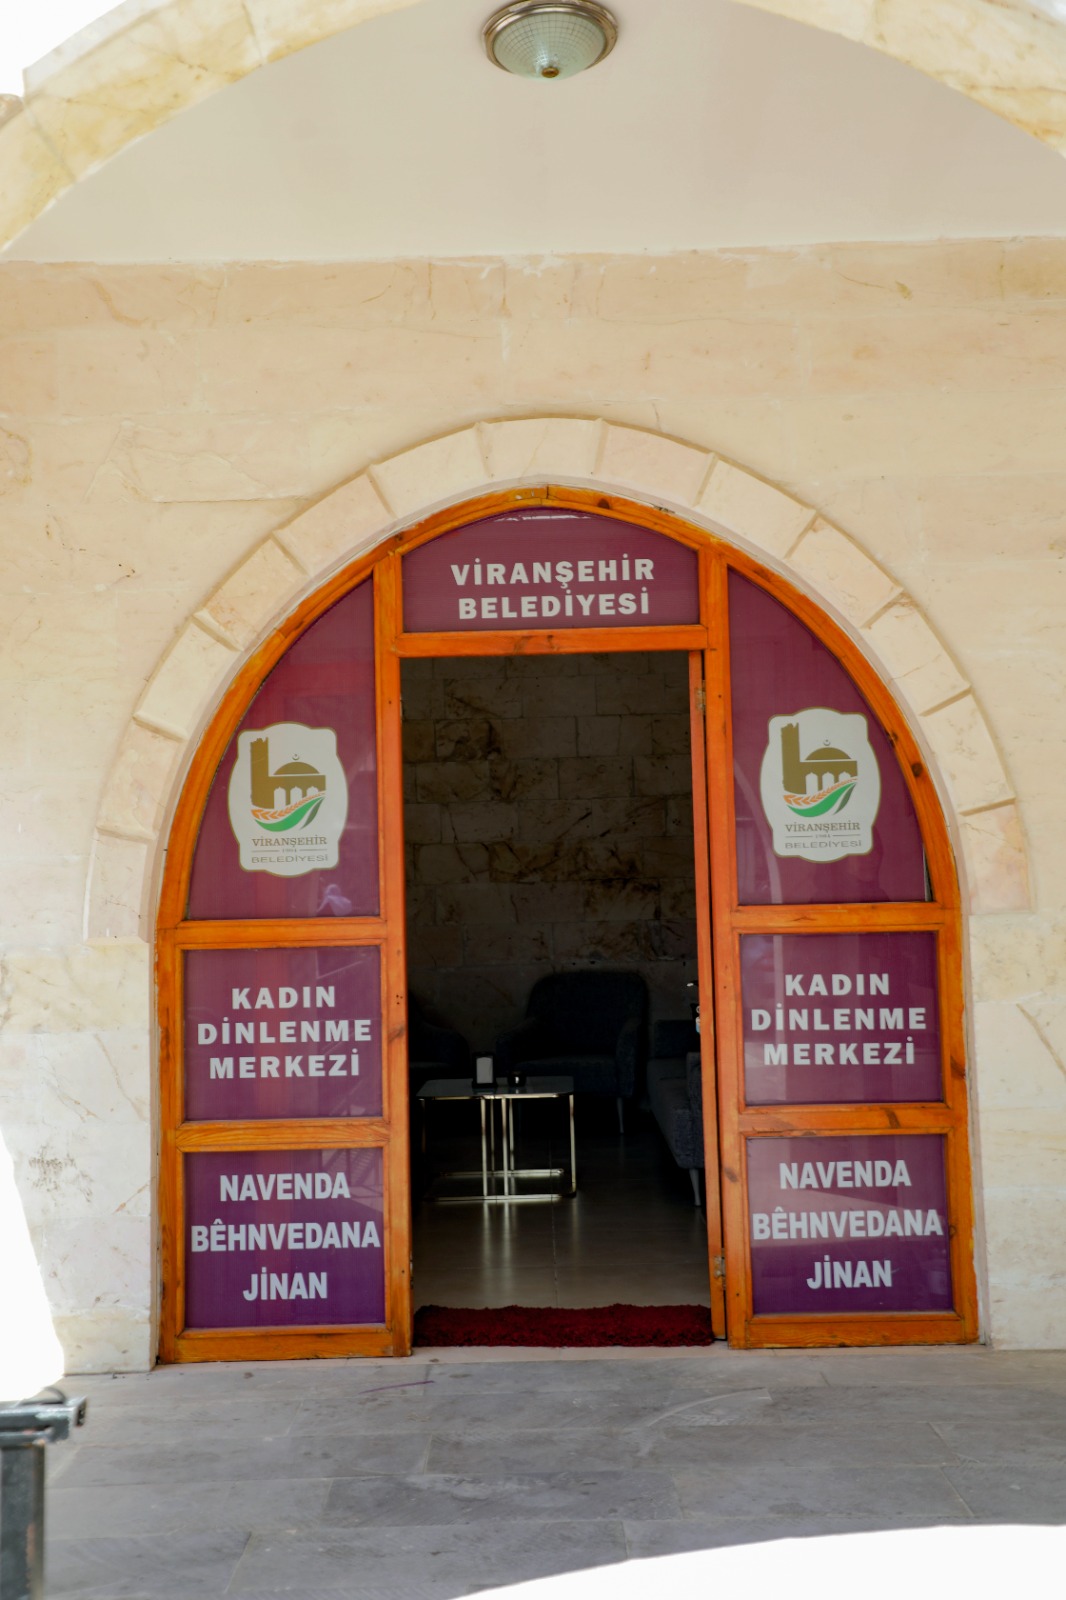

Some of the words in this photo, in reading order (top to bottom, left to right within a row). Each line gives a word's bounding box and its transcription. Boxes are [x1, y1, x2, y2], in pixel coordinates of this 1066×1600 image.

[450, 553, 655, 589] VİRANŞEHİR
[458, 587, 650, 619] BELEDİYESİ
[251, 834, 328, 848] VİRANŞEHİR
[785, 820, 861, 834] VİRANŞEHİR
[251, 853, 329, 864] BELEDİYESİ
[784, 839, 862, 849] BELEDİYESİ
[231, 986, 336, 1009] KADIN
[785, 973, 890, 997] KADIN
[197, 1016, 372, 1045] DİNLENME
[751, 1003, 927, 1031] DİNLENME
[209, 1048, 360, 1079] MERKEZİ
[763, 1036, 915, 1066] MERKEZİ
[219, 1171, 351, 1202] NAVENDA
[779, 1159, 912, 1189] NAVENDA
[190, 1218, 381, 1252] BÊHNVEDANA
[752, 1207, 944, 1240] BÊHNVEDANA
[242, 1266, 328, 1301] JİNAN
[806, 1254, 893, 1290] JİNAN
